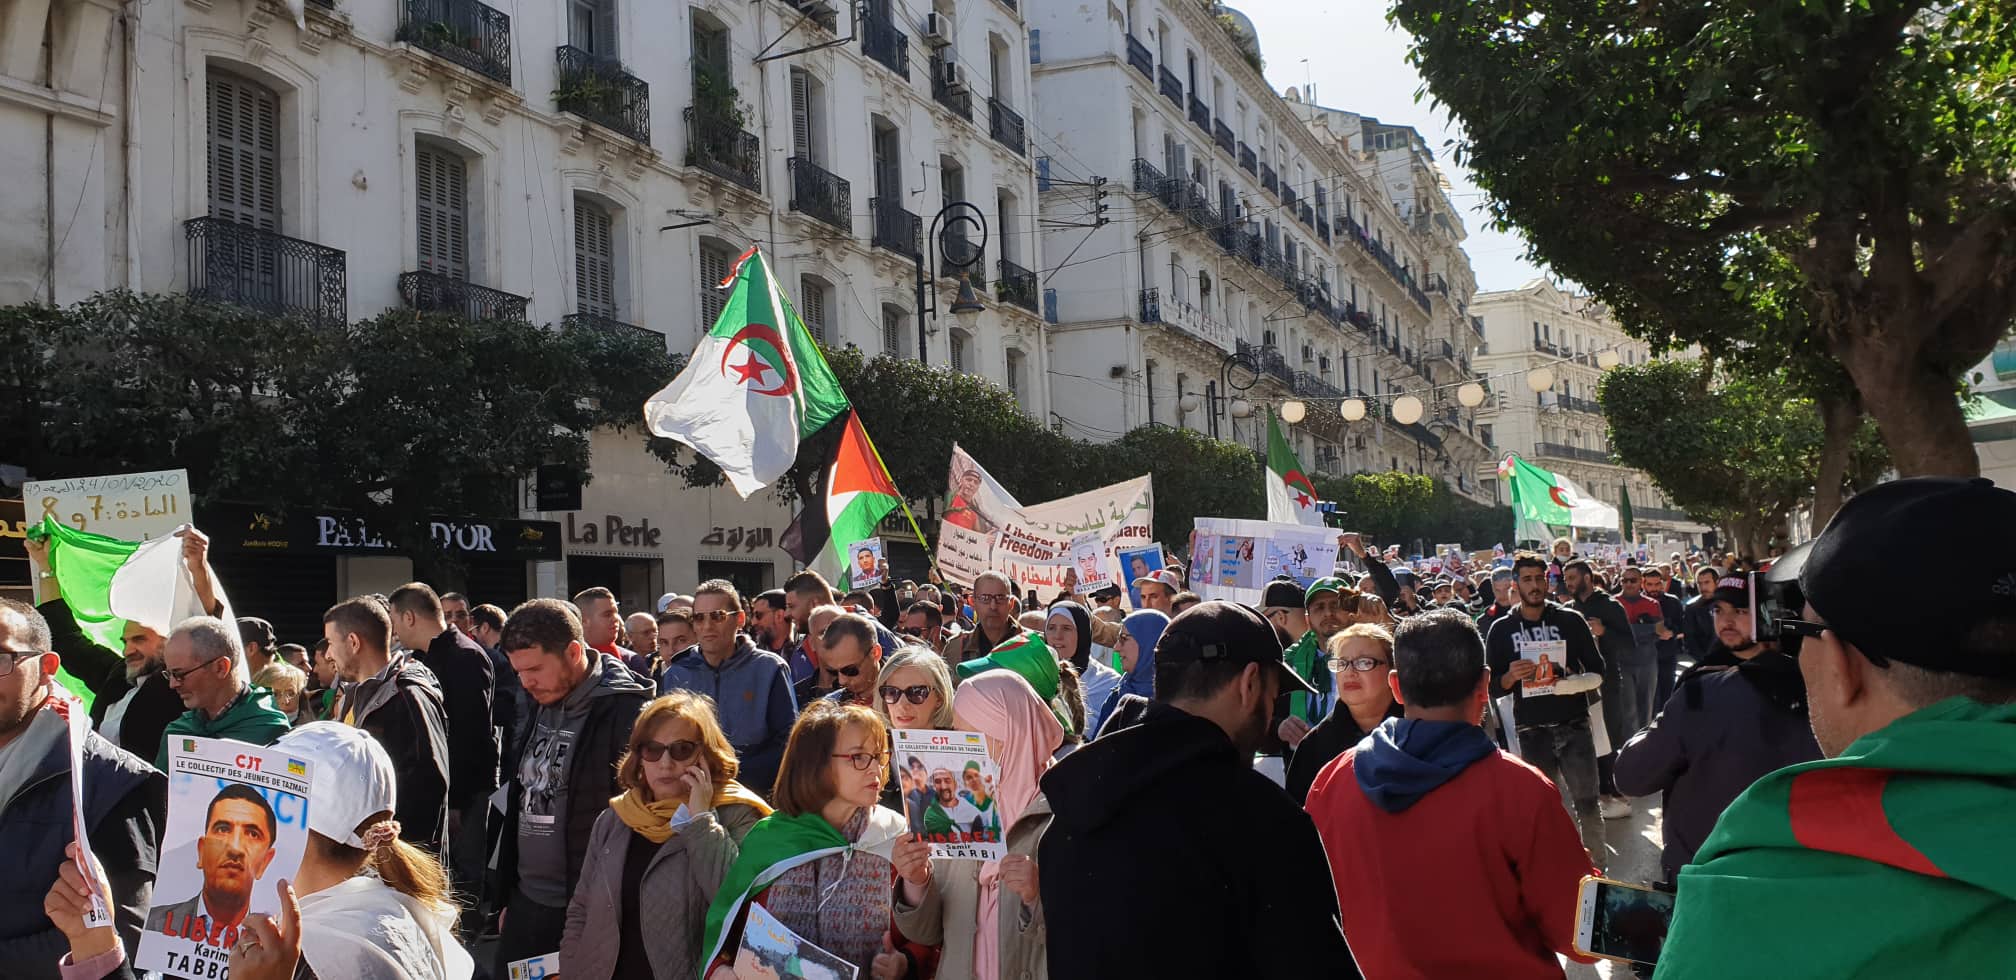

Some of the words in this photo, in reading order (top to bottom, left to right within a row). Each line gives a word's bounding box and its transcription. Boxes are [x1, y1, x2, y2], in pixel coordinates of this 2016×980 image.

[430, 521, 496, 551] D'OR
[567, 512, 598, 544] La
[606, 515, 662, 547] Perle
[999, 533, 1054, 561] Freedom
[1511, 625, 1561, 653] PARIS
[931, 736, 949, 745] CJT
[235, 753, 263, 772] CJT
[176, 759, 186, 769] LE
[188, 762, 226, 776] COLLECTIF
[228, 768, 242, 778] DES
[244, 771, 270, 785] JEUNES
[271, 777, 280, 787] DE
[282, 780, 309, 795] TAZMALT
[163, 911, 247, 950] LIBER
[167, 952, 230, 980] TABBO
[194, 943, 229, 963] Karim
